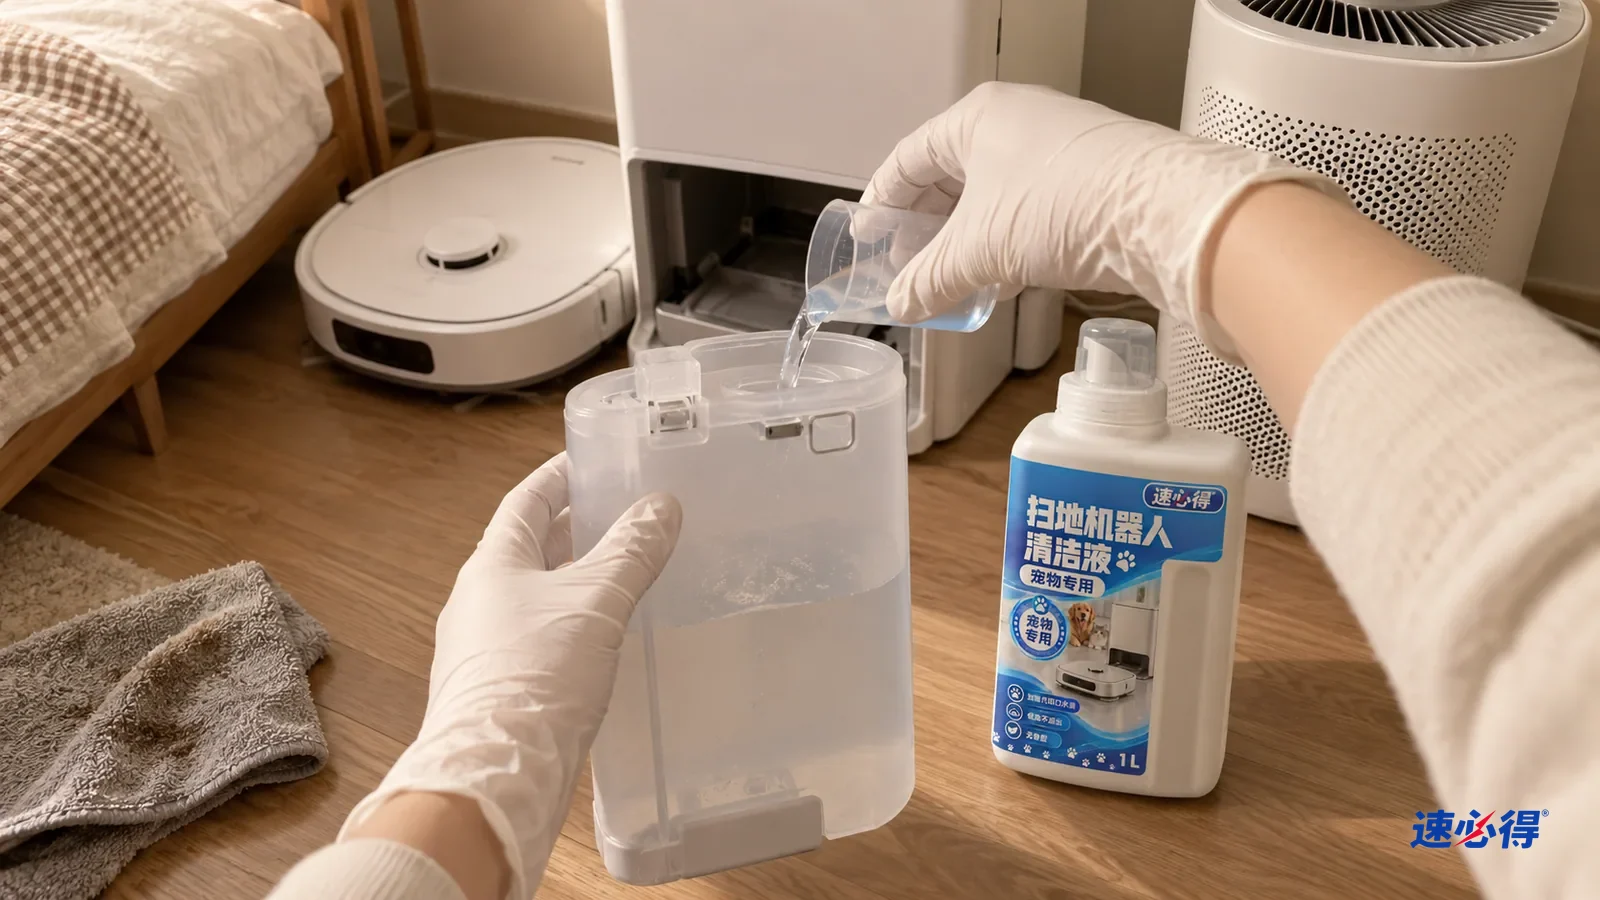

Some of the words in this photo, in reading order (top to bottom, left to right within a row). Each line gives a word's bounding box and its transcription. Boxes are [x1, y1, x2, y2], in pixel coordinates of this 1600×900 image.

[1026, 494, 1173, 549] 扫地机器人
[1023, 531, 1112, 575] 清洁液
[1030, 569, 1094, 594] 宠物专用
[1026, 614, 1053, 631] 宠物
[1025, 628, 1052, 646] 专用
[1119, 753, 1141, 769] 1L
